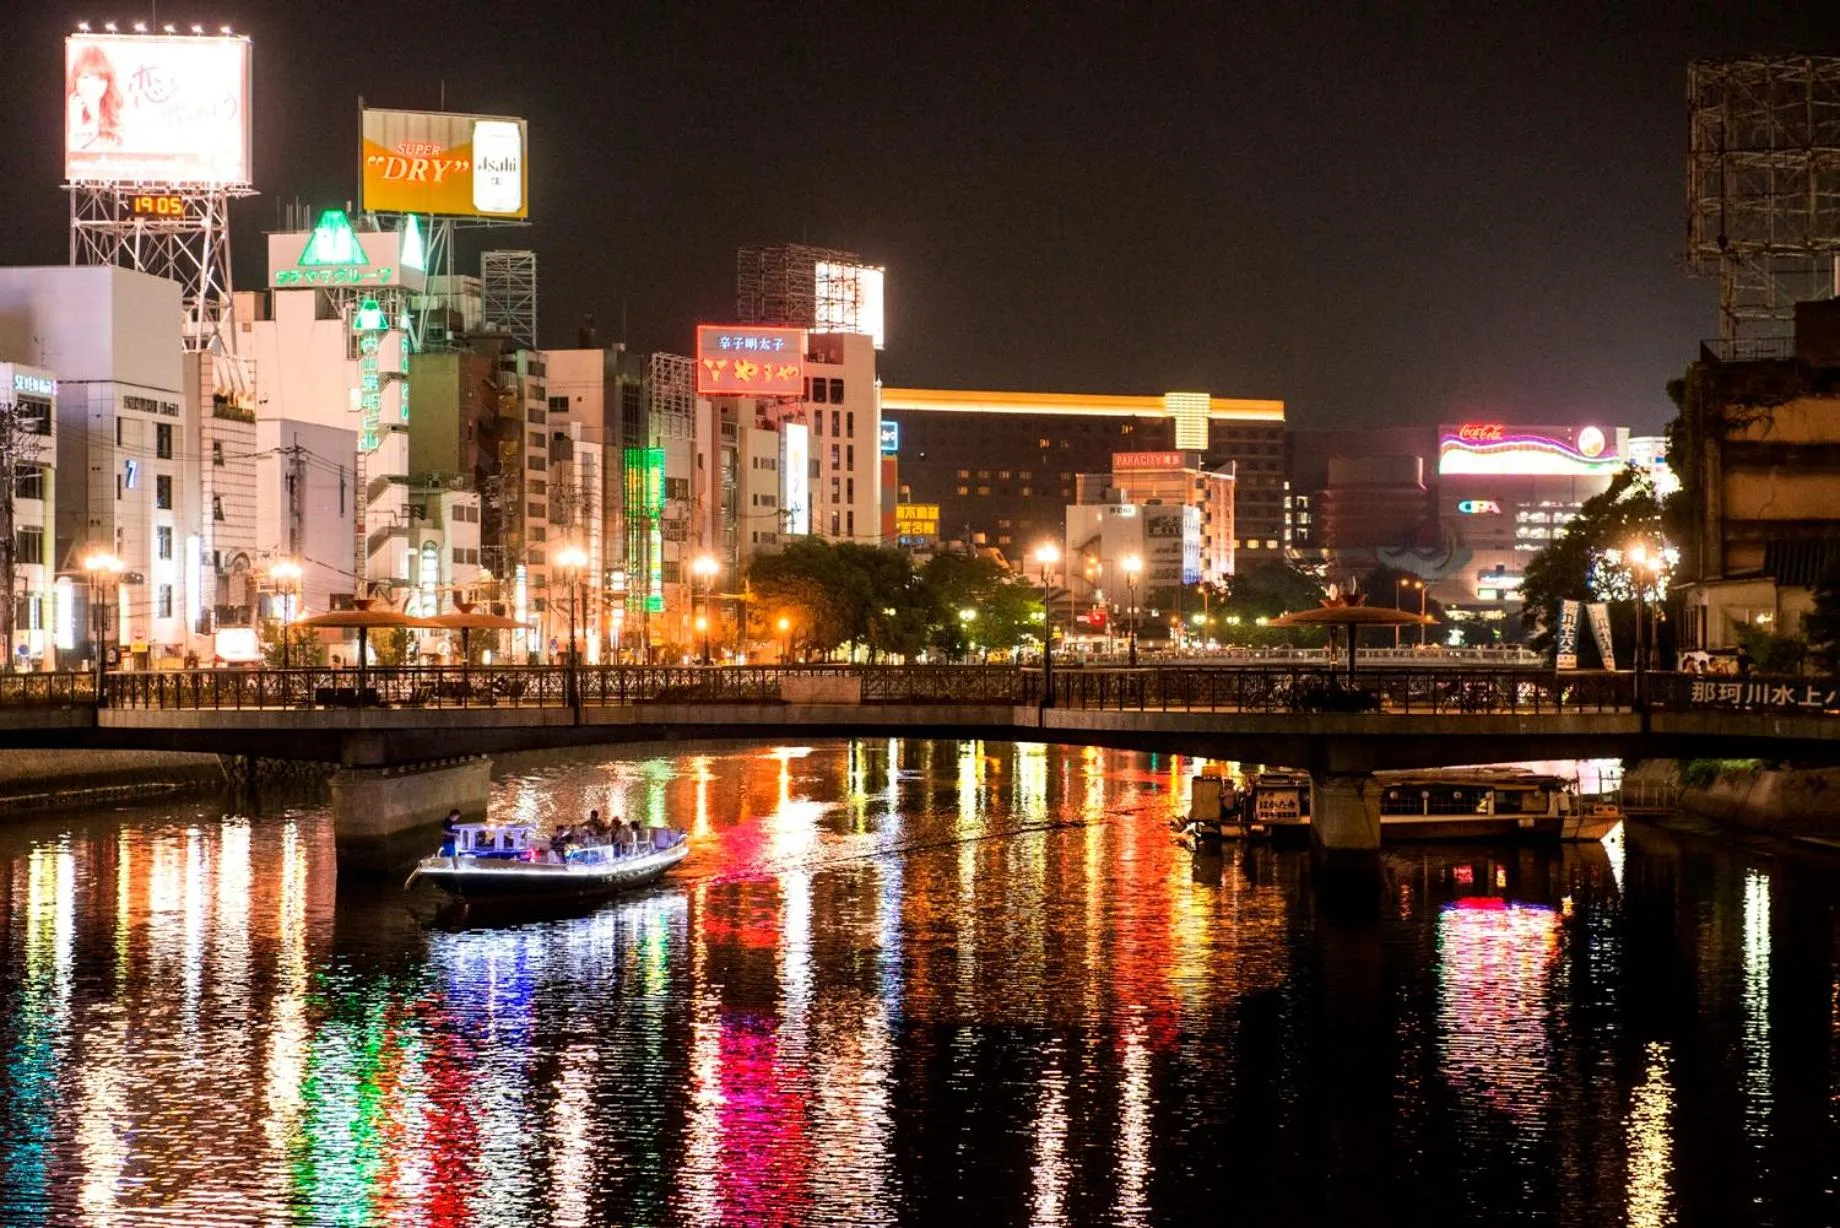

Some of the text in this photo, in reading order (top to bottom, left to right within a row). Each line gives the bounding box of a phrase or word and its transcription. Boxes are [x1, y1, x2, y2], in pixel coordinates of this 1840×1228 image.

[397, 143, 441, 156] SUPER
[275, 267, 393, 285] ウチヤマグループ
[719, 336, 784, 351] 辛子明太子
[125, 459, 138, 489] 7
